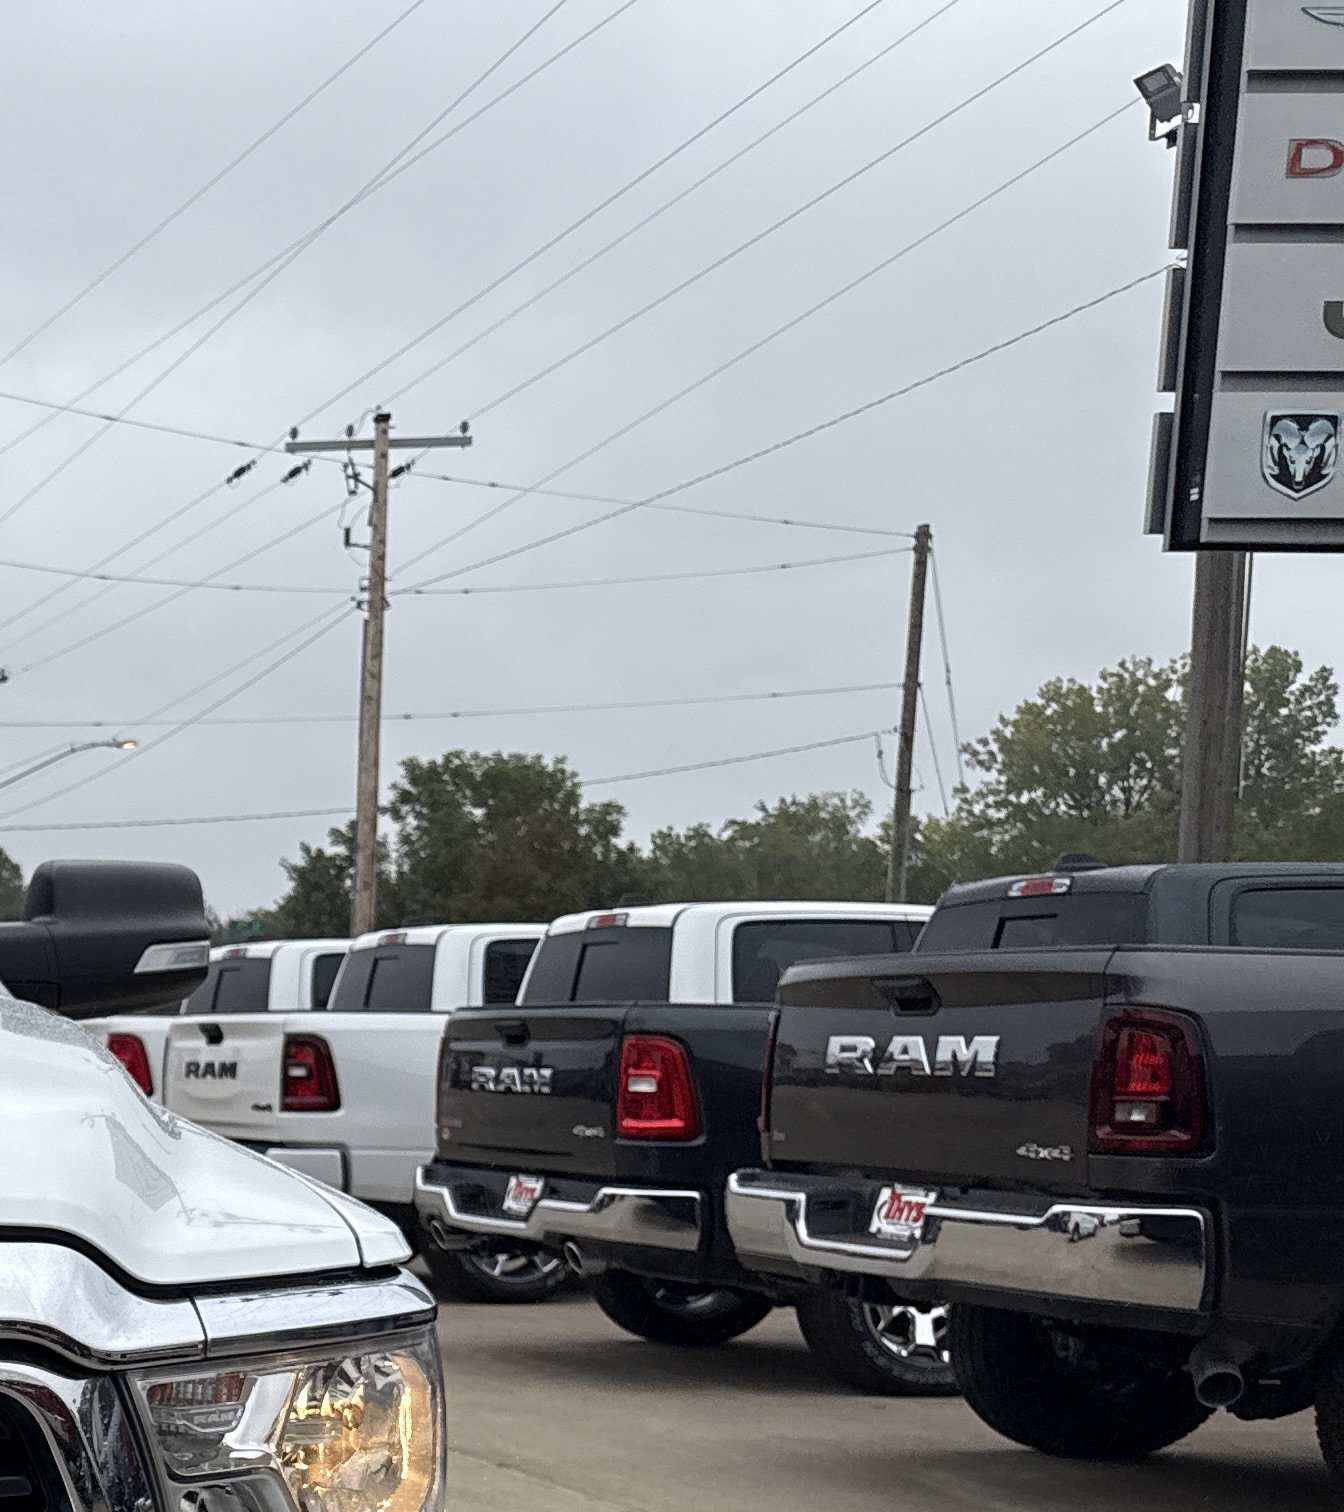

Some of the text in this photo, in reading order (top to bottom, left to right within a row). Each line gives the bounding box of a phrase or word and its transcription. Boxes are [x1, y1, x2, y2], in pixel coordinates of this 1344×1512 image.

[184, 1062, 238, 1079] RAM
[824, 1035, 1000, 1077] RAM
[471, 1065, 554, 1094] RAM
